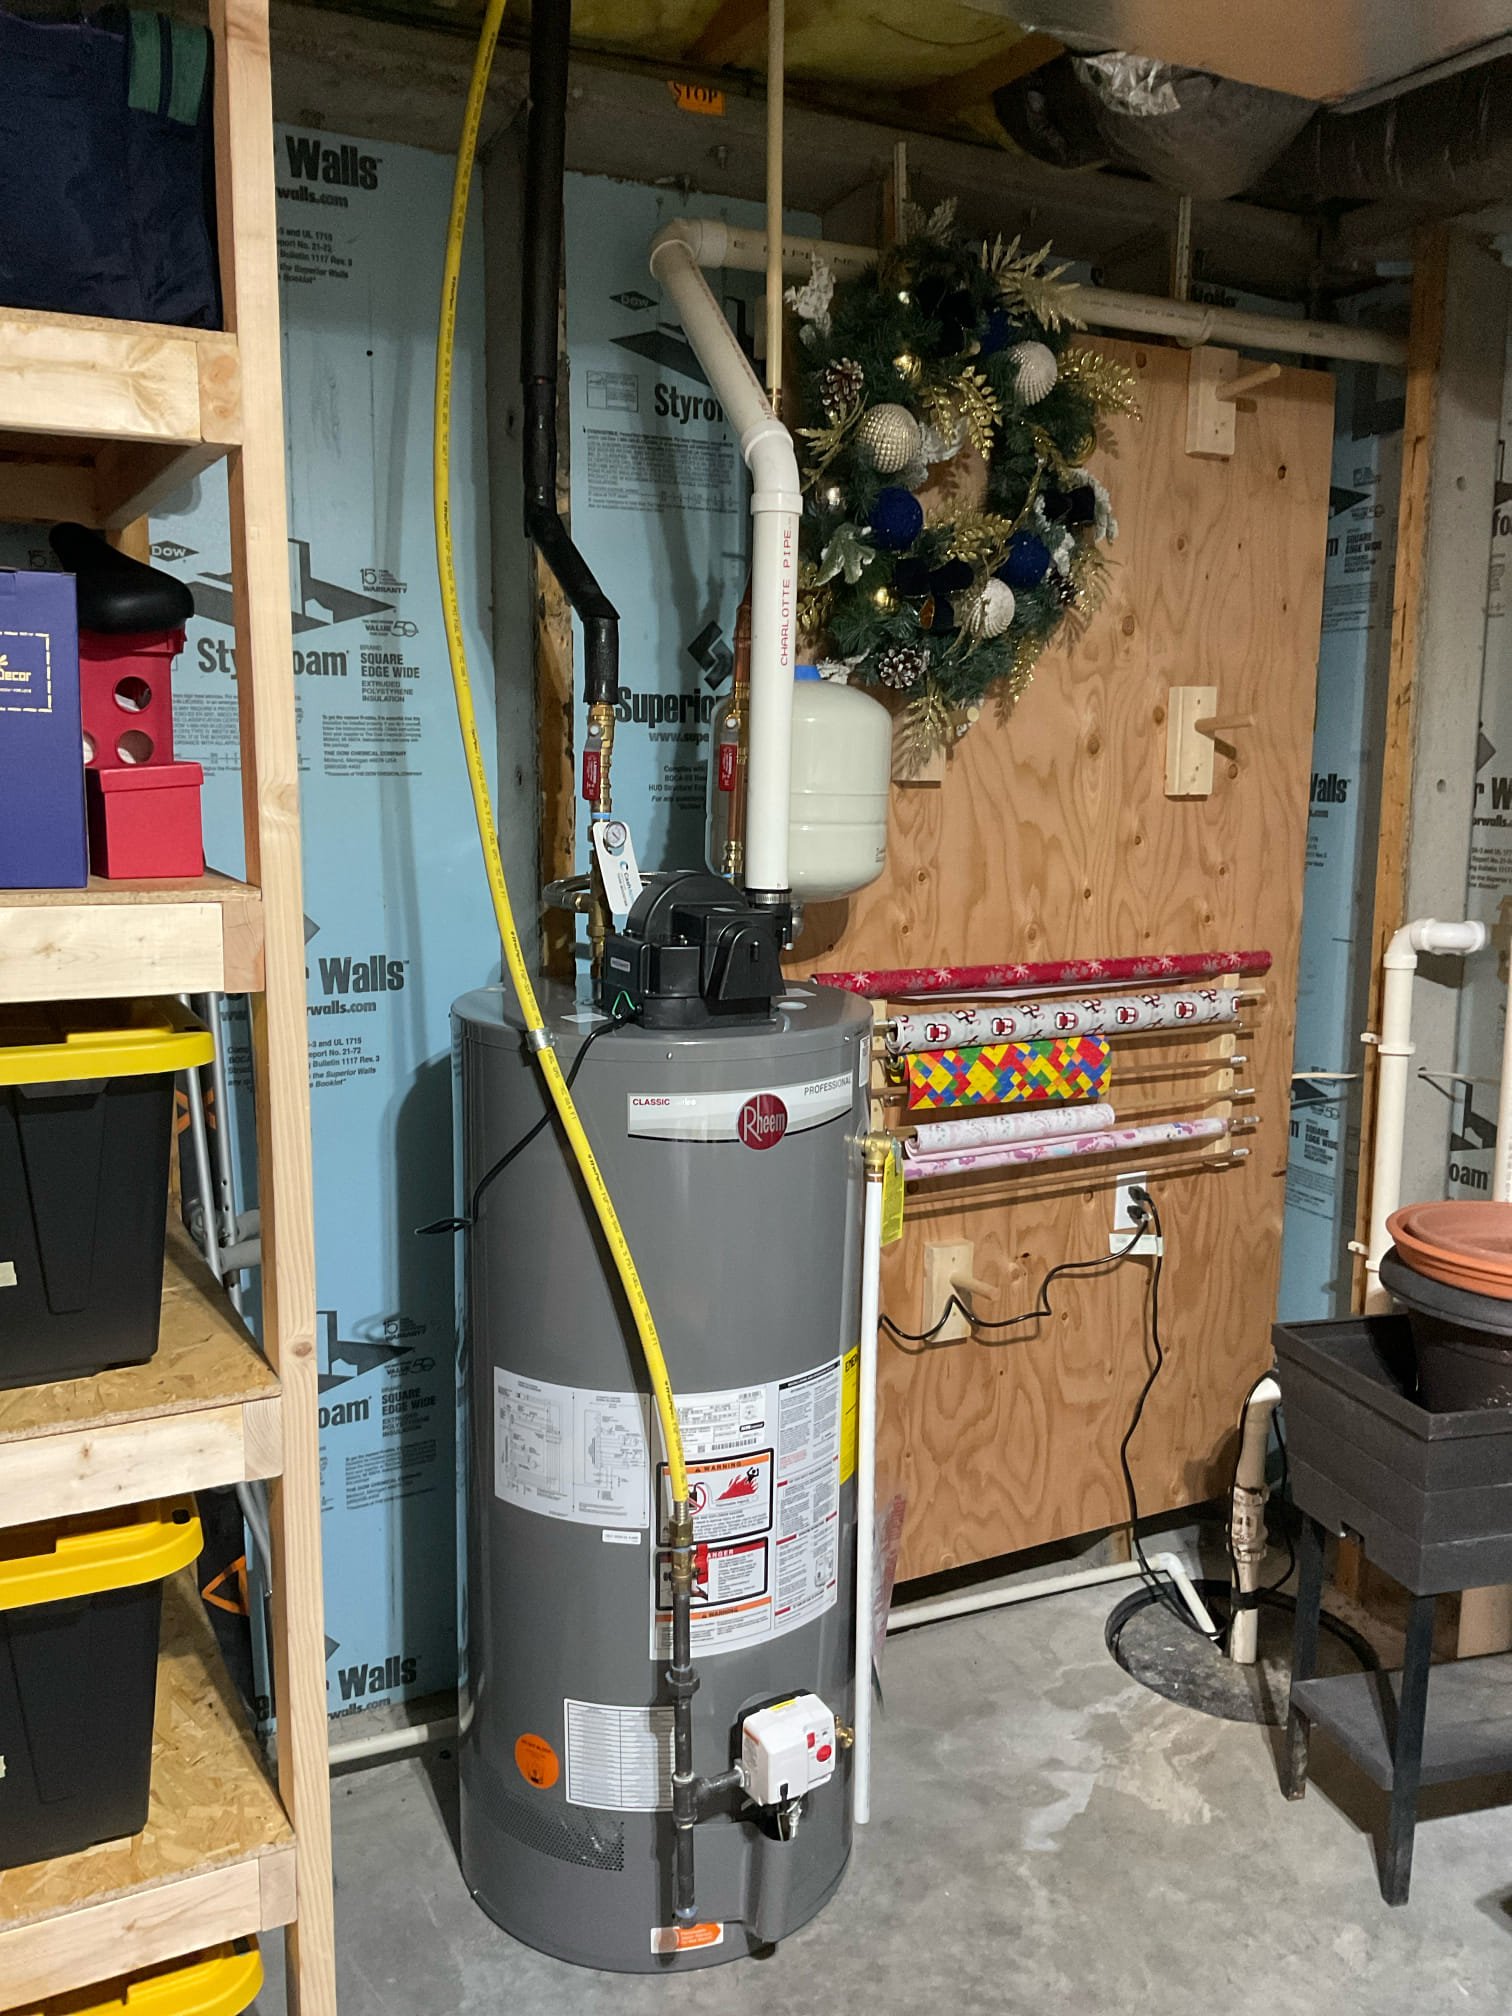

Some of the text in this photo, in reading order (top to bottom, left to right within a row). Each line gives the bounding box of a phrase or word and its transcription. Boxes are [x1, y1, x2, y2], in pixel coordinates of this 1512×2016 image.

[360, 568, 377, 584] 15
[780, 529, 792, 666] CHARLOTTE PIPE
[360, 653, 403, 665] SQUARE
[361, 666, 420, 679] EDGE WIDE
[361, 680, 400, 688] EXTRUDED
[361, 687, 413, 696] POLYSTYRENE
[362, 695, 404, 703] INSULATION
[616, 686, 730, 728] Superio
[318, 955, 405, 995] Walls
[333, 1038, 344, 1046] UL
[342, 1047, 361, 1055] 21-72
[313, 1059, 340, 1068] Bulletin
[342, 1057, 358, 1065] 1117
[326, 1069, 357, 1078] Superior
[357, 1066, 376, 1075] Walls
[804, 1076, 852, 1096] PROFESSIONAL
[632, 1098, 670, 1106] CLASSIC
[744, 1095, 785, 1142] Rheem
[1448, 1163, 1488, 1190] oam
[382, 1388, 421, 1404] SQUARE
[382, 1396, 436, 1415] EDGE WIDE
[704, 1461, 742, 1471] WARNING
[707, 1549, 734, 1559] ANGER
[338, 1655, 417, 1701] Walls
